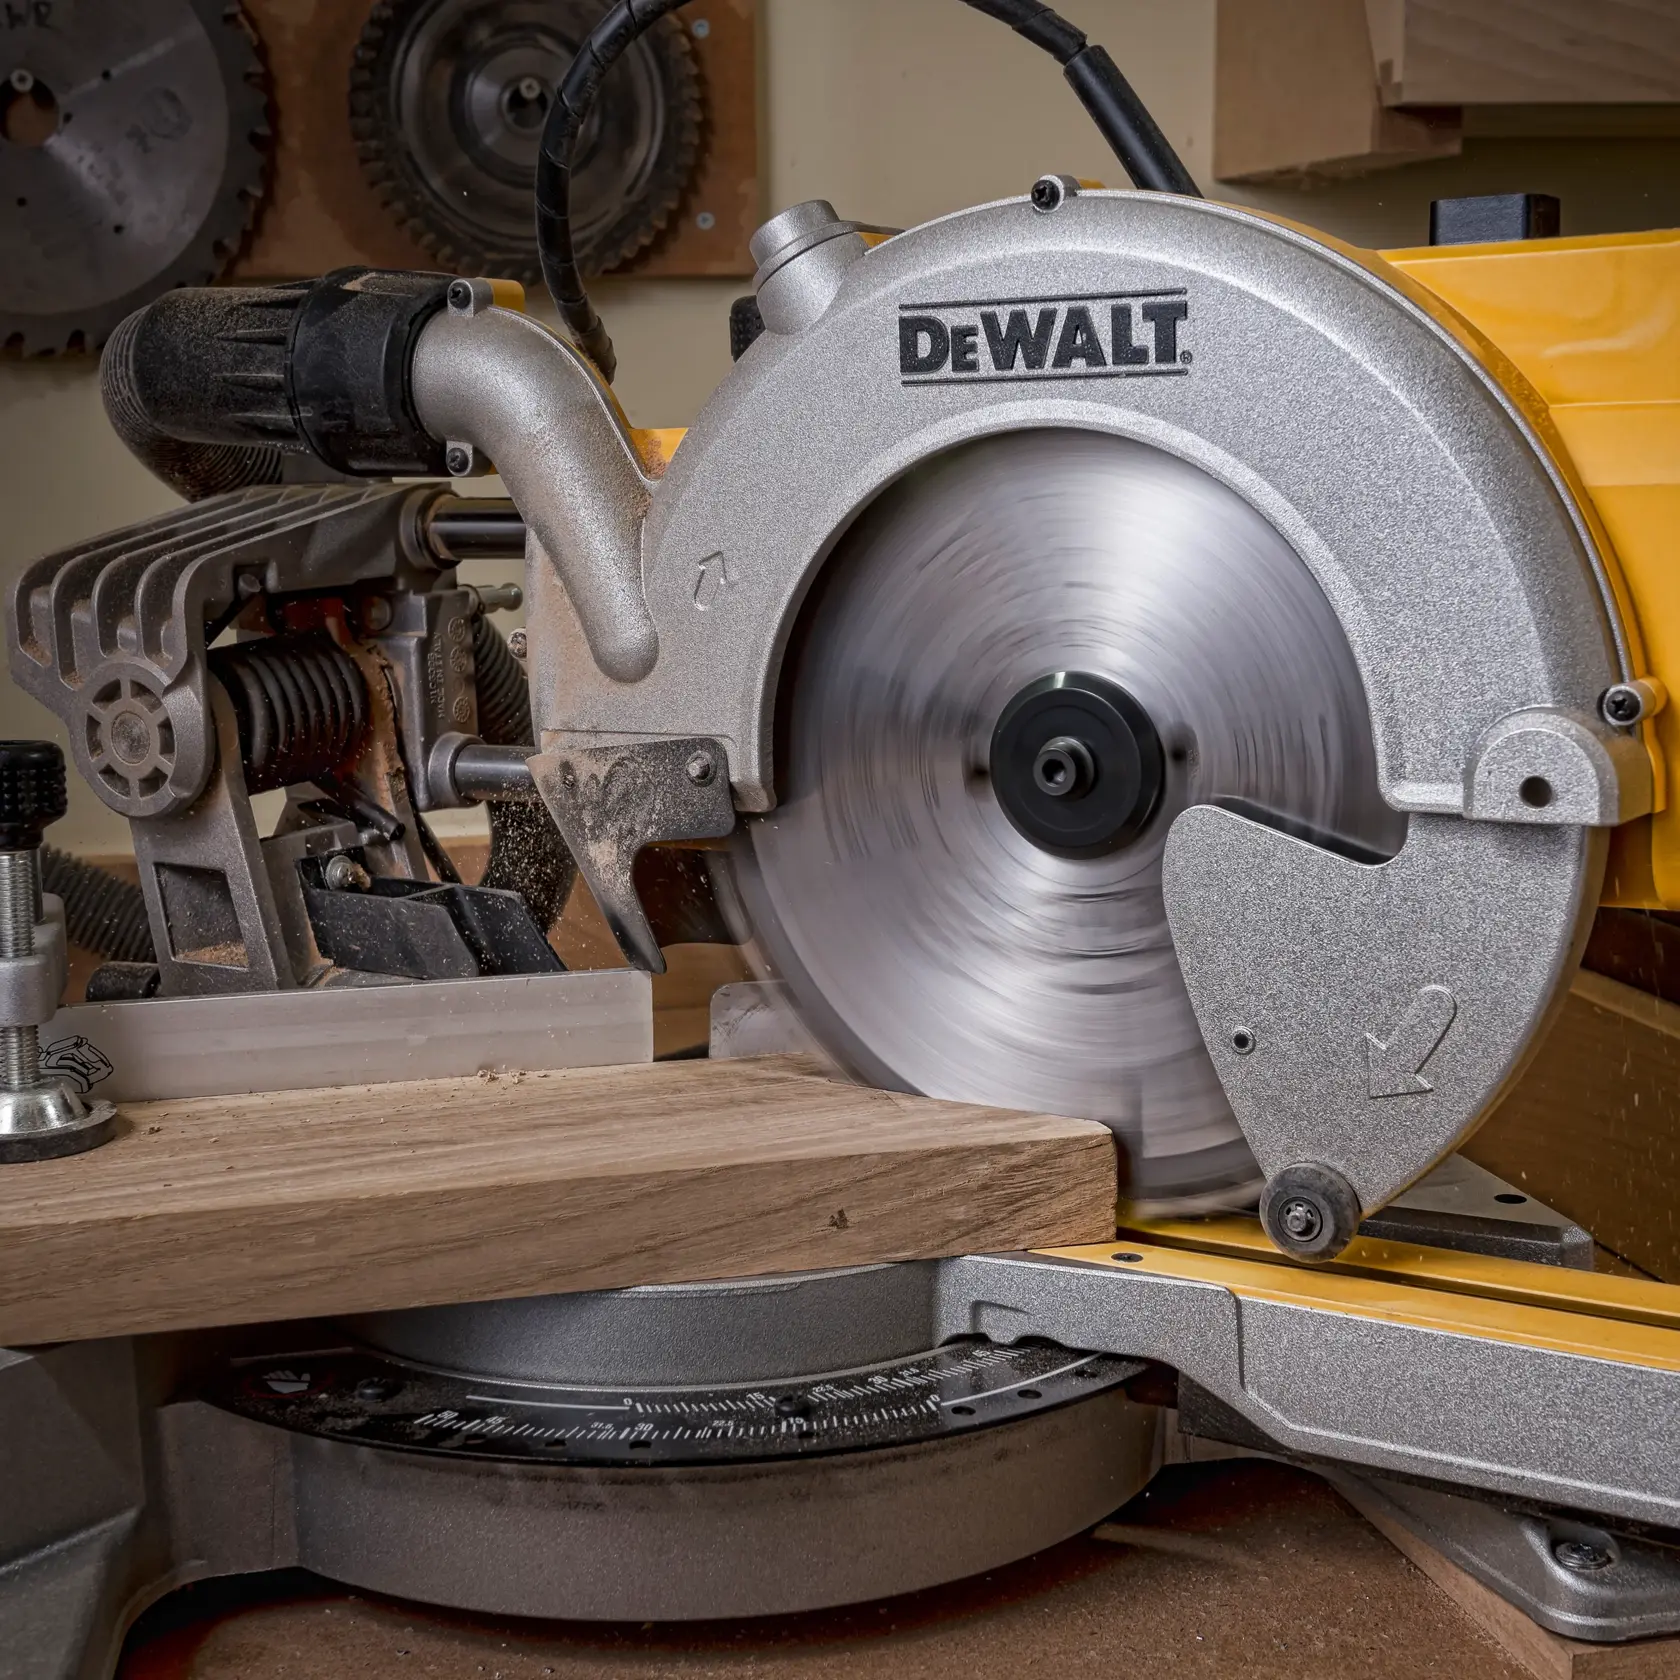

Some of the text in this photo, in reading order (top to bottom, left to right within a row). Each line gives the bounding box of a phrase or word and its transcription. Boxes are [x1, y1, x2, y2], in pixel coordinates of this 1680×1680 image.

[433, 632, 443, 666] ITALY
[437, 687, 445, 719] MADE
[623, 1397, 633, 1405] 0
[746, 1391, 765, 1400] 15
[634, 1422, 654, 1431] 30
[930, 1394, 941, 1402] 0
